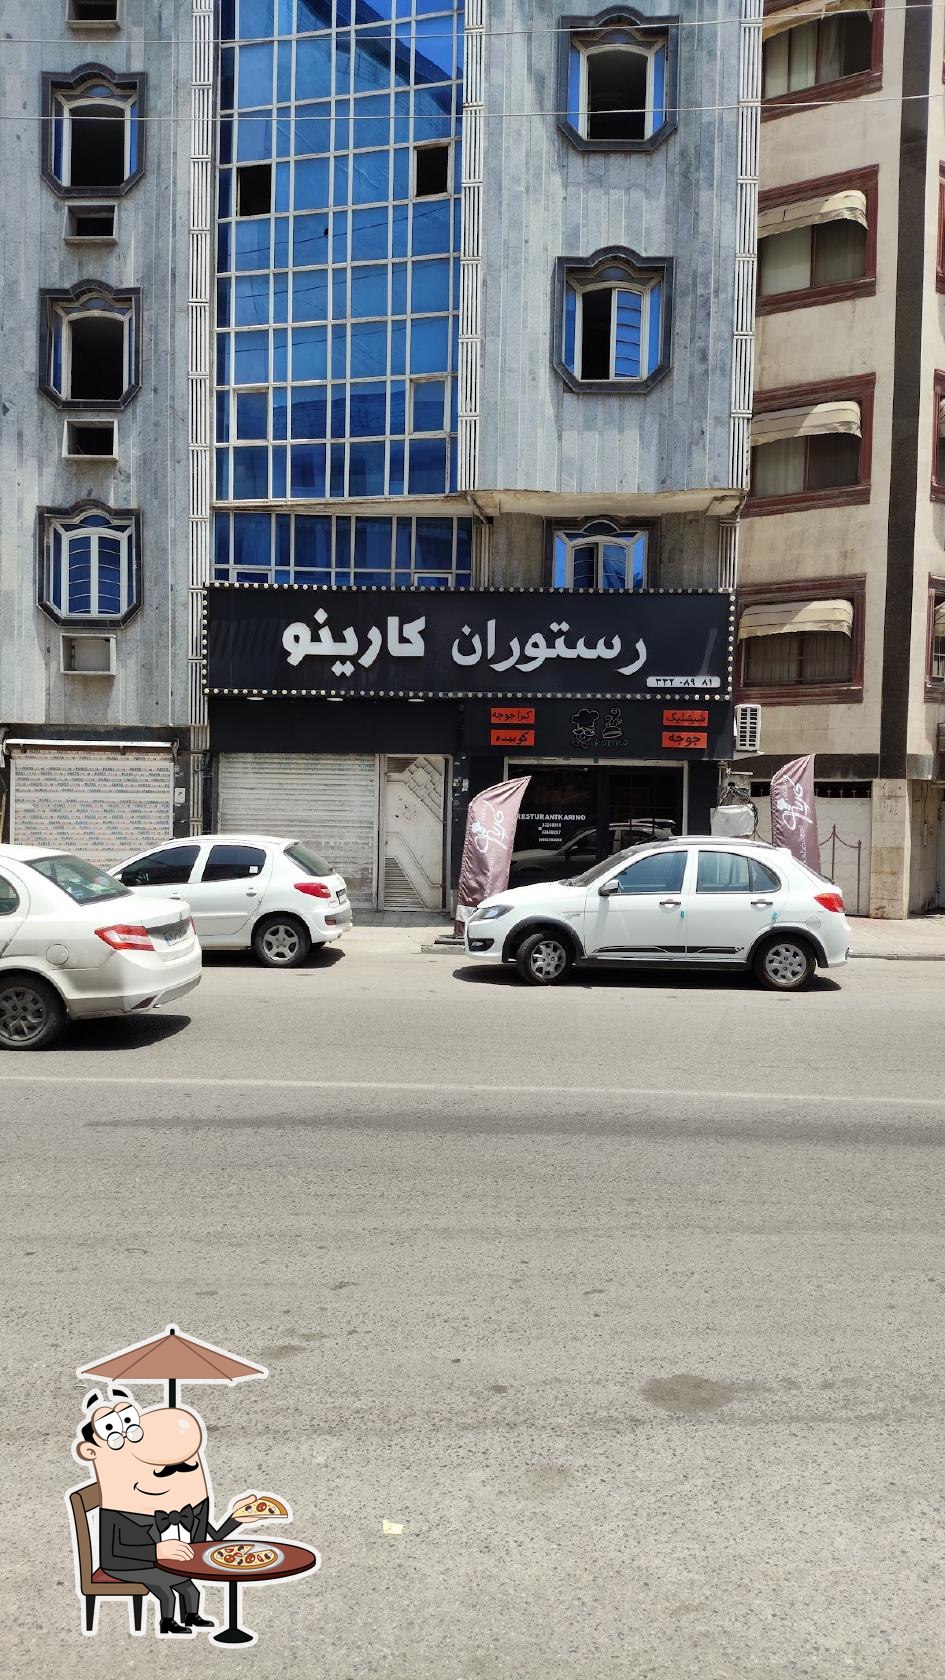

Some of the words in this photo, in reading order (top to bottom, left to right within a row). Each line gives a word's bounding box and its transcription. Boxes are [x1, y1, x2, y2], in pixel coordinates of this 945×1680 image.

[281, 608, 426, 677] کارینو
[451, 617, 647, 676] رستوران
[666, 711, 706, 724] شیشلیک
[495, 731, 529, 744] کوبیده
[668, 734, 701, 747] جوجه
